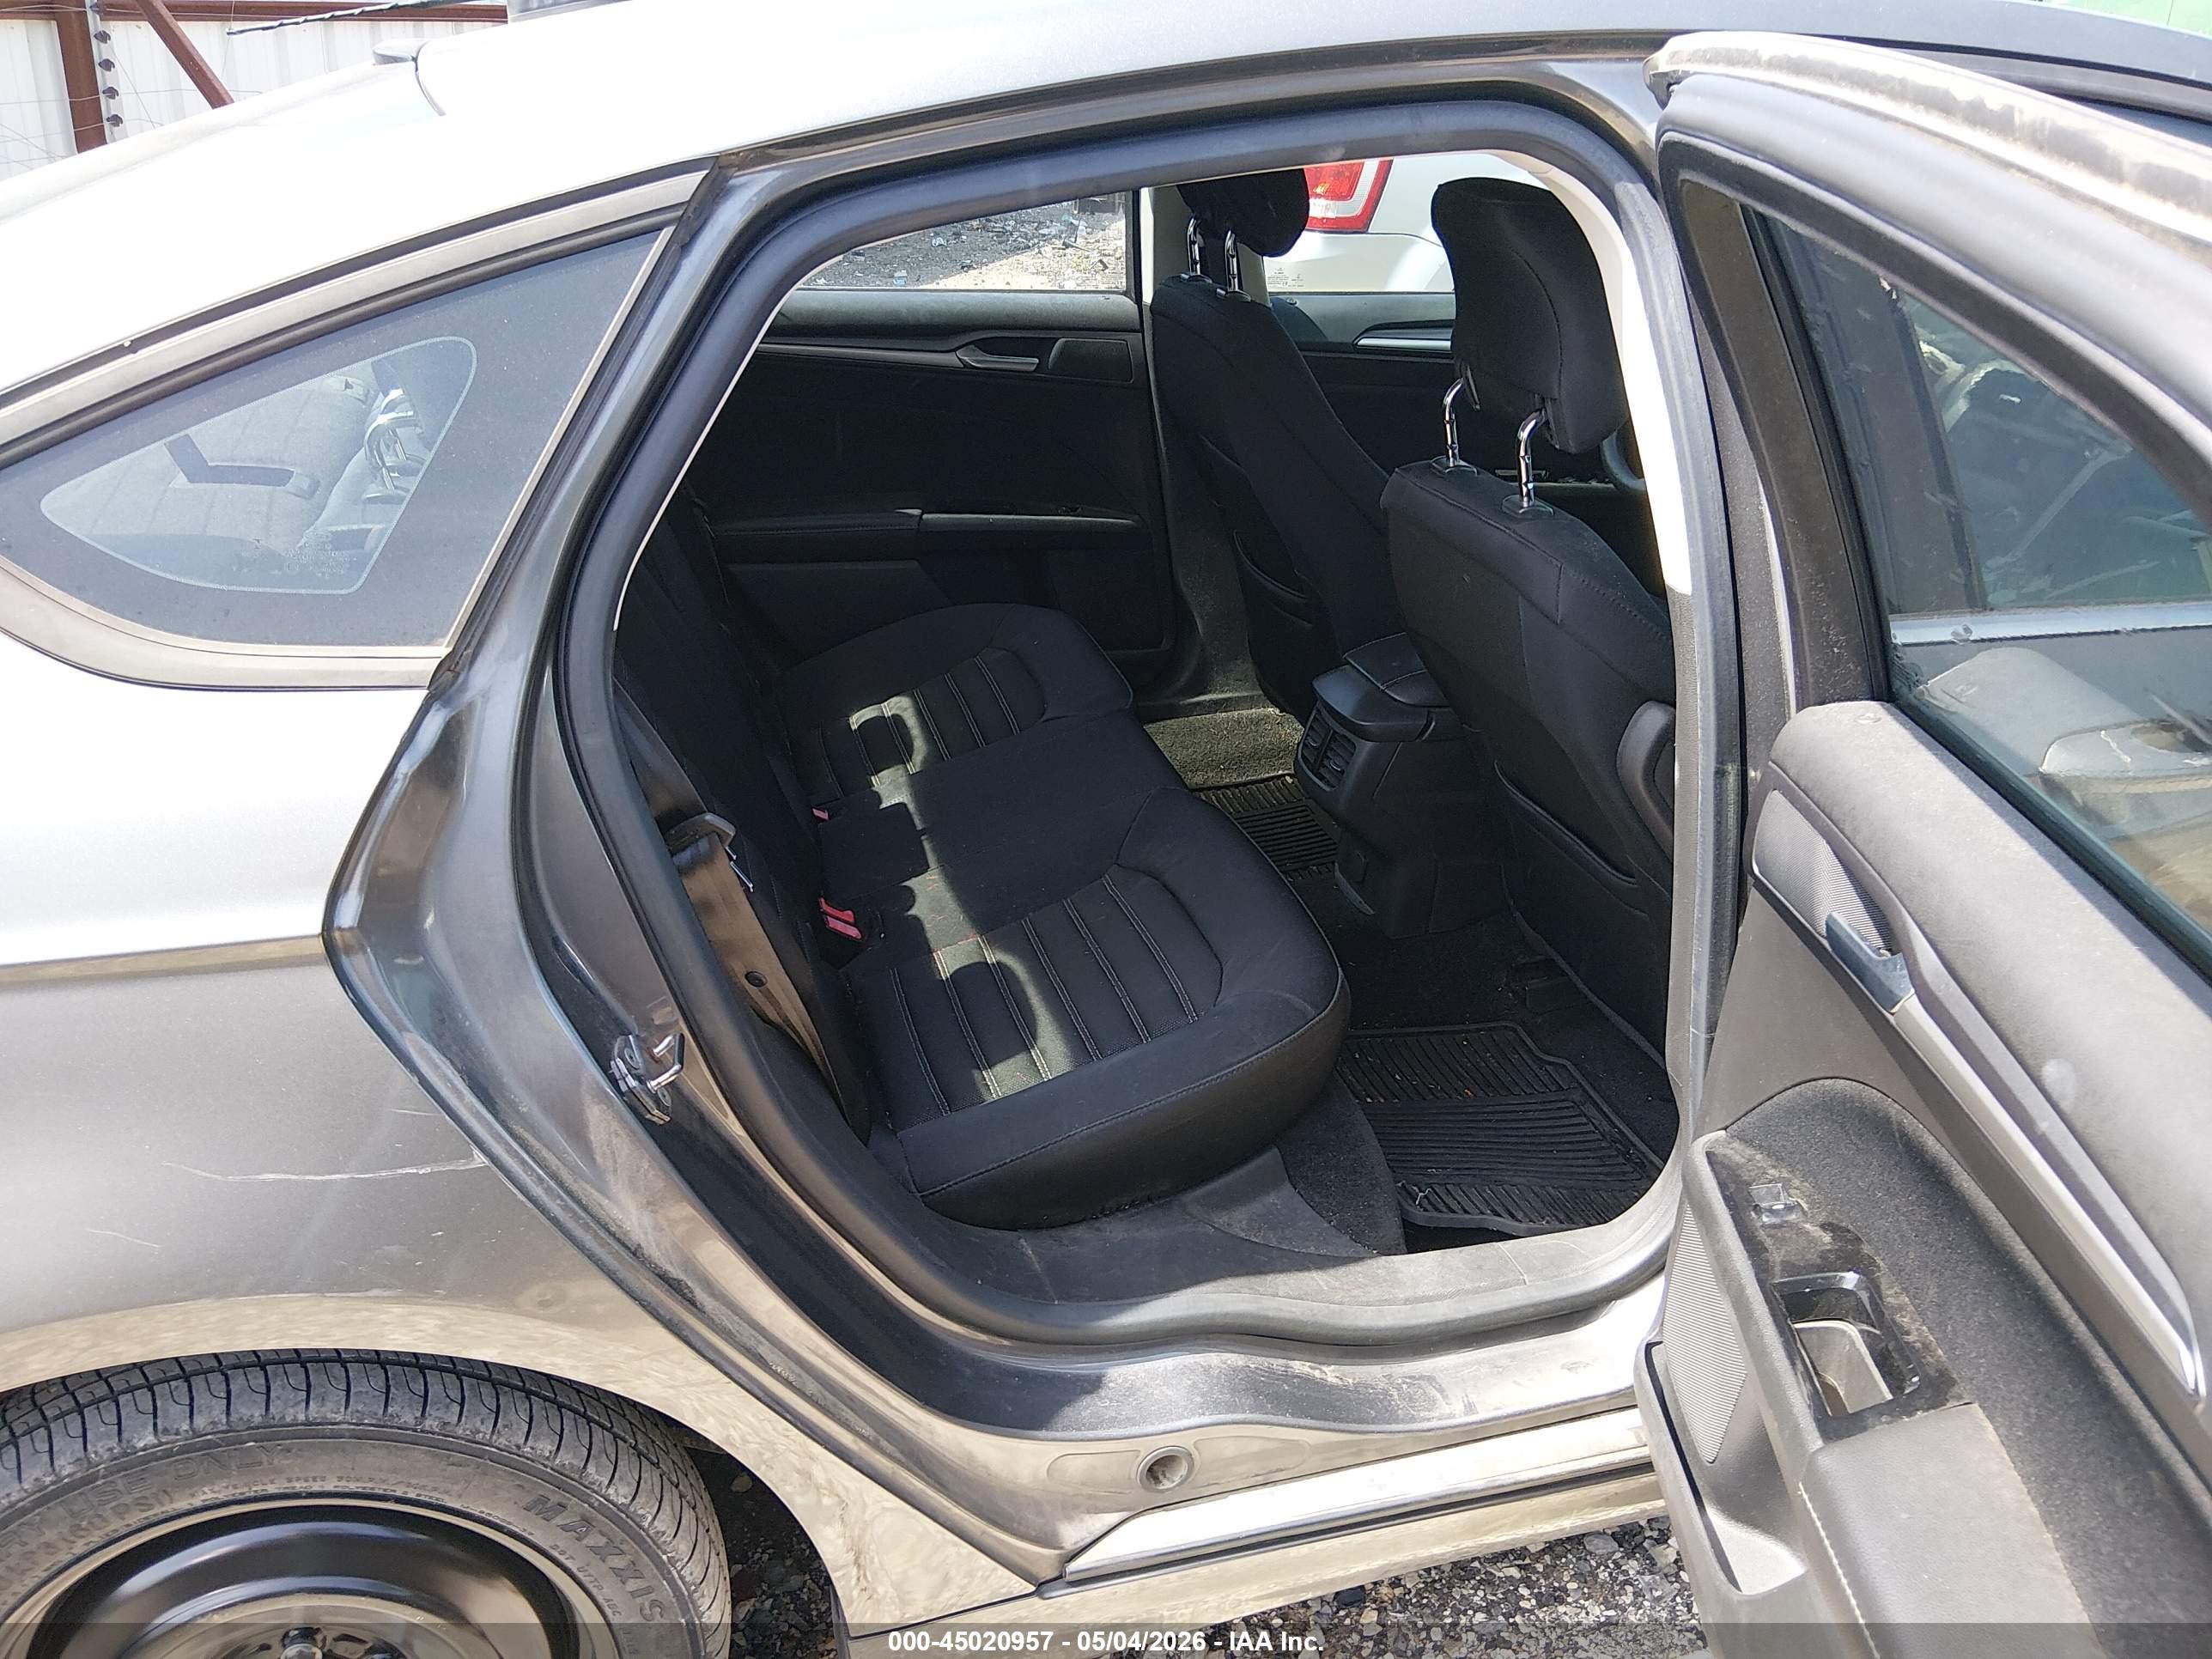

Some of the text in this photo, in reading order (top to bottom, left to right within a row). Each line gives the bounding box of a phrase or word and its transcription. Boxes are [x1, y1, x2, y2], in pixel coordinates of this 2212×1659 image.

[61, 1443, 283, 1520] USE ONLY
[522, 1493, 666, 1622] MAXXIS
